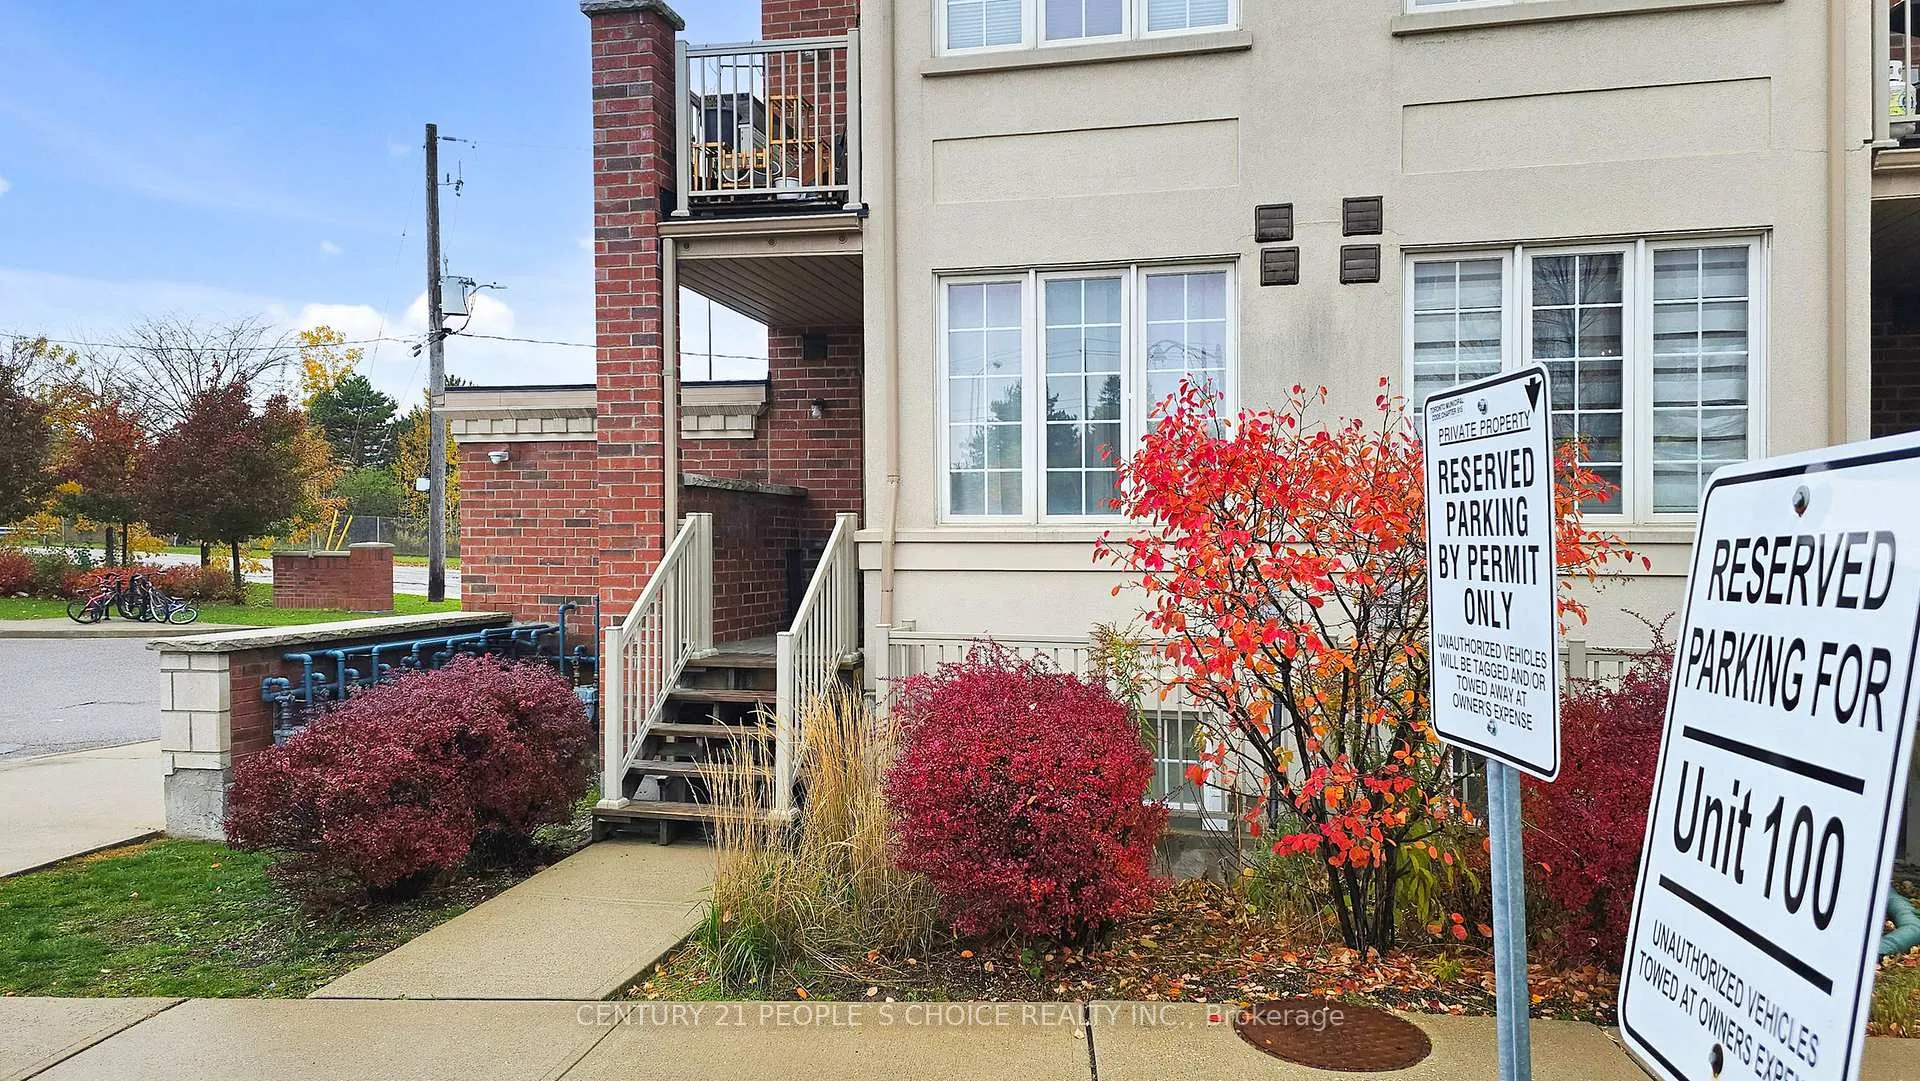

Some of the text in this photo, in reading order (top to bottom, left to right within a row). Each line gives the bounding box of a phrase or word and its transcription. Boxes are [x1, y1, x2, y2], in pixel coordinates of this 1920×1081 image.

[1438, 410, 1530, 442] PRIVATE PROPERTY
[1438, 447, 1535, 494] RESERVED
[1446, 496, 1529, 537] PARKING
[1439, 544, 1539, 585] BY PERMIT
[1708, 530, 1896, 610] RESERVED
[1464, 587, 1513, 630] ONLY
[1437, 633, 1547, 669] UNAUTHORIZED VEHICLES
[1440, 652, 1546, 691] WILL BE TAGGED AND/OR
[1457, 675, 1527, 708] TOWED AWAY AT
[1684, 627, 1892, 732] PARKING FOR
[1453, 693, 1533, 731] OWNER'S EXPENSE
[1673, 760, 1845, 931] Unit 100
[1639, 950, 1678, 1003] TOWED
[1679, 984, 1697, 1017] AT
[1698, 997, 1752, 1066] OWNERS
[1652, 919, 1819, 1068] UNAUTHORIZED VEHICLES
